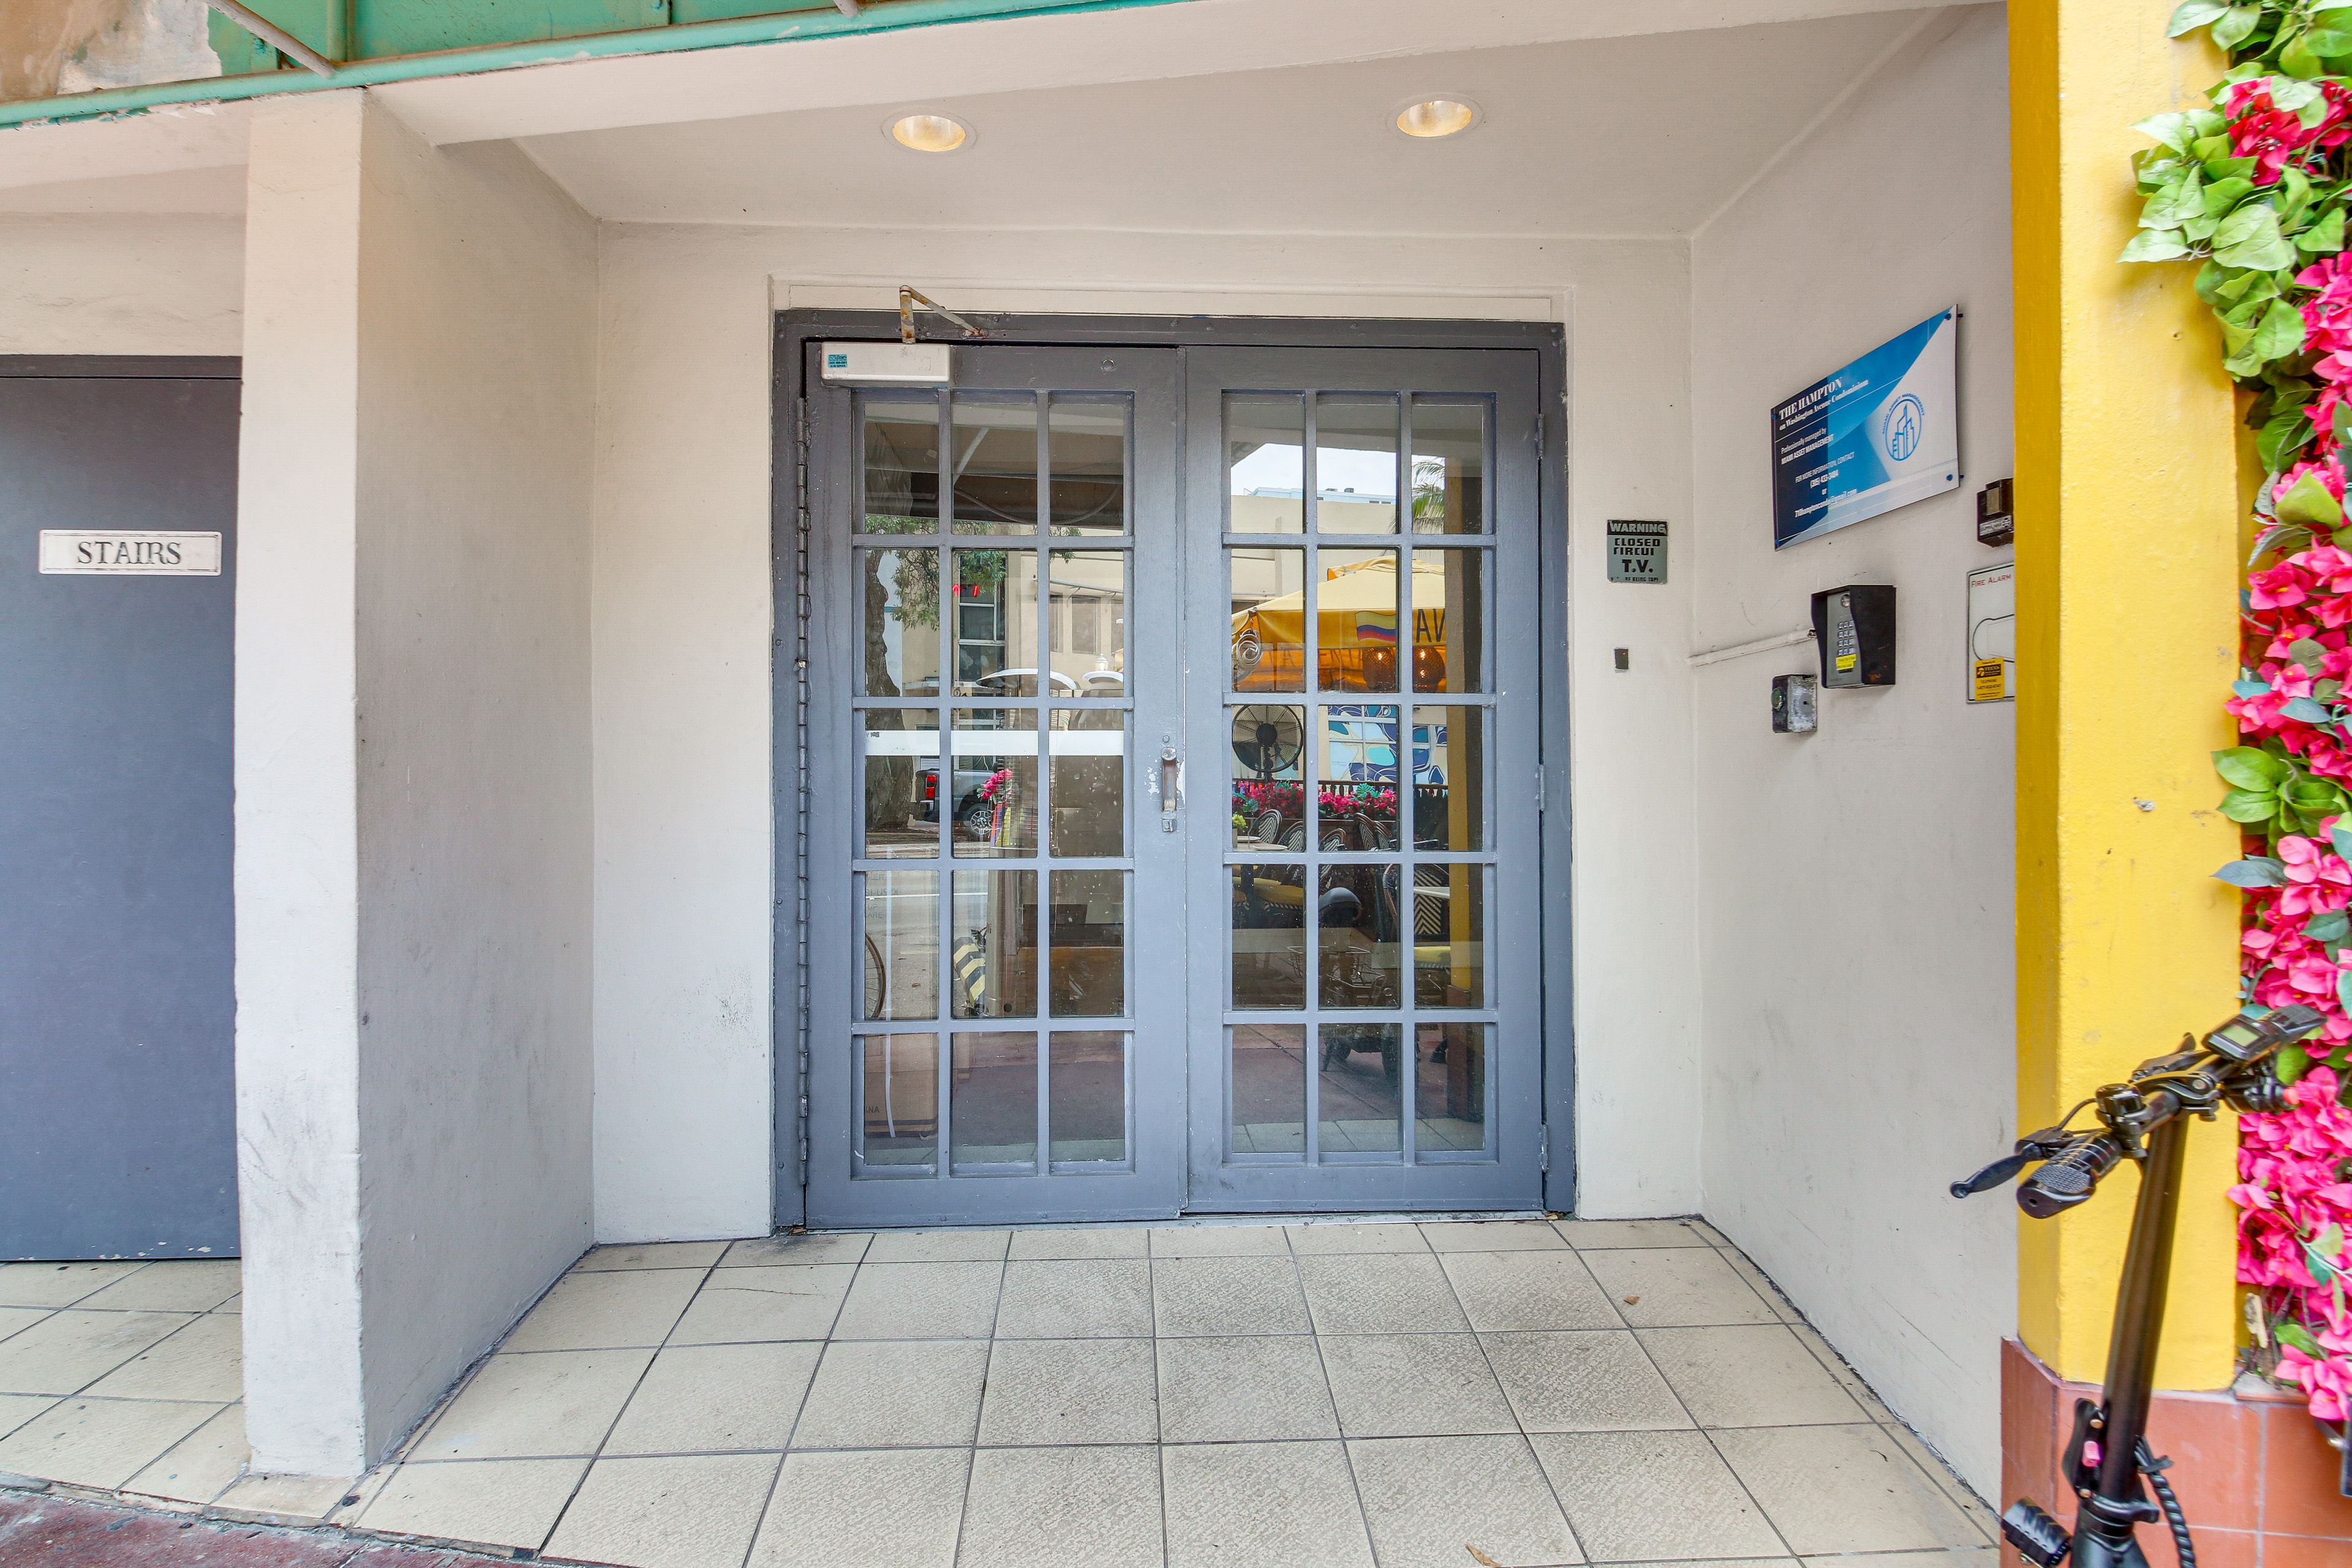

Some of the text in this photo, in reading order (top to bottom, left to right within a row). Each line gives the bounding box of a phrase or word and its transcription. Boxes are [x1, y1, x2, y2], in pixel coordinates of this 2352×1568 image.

[1779, 377, 1842, 420] THE HAMPTON
[1786, 409, 1813, 427] Washington
[1813, 400, 1831, 413] Avenue
[1831, 380, 1868, 402] Condominium
[1781, 438, 1804, 454] Professionally
[1805, 429, 1822, 443] managed
[1781, 434, 1834, 465] MIAMI ASSET MANAGEMENT
[1802, 470, 1812, 480] MORE
[1837, 451, 1855, 464] CONTACT
[1611, 523, 1666, 533] WARNING
[78, 541, 182, 565] STAIRS
[1615, 538, 1660, 546] CLOSED
[1622, 559, 1654, 573] T.V.
[1971, 574, 2011, 587] FIRE ALARM
